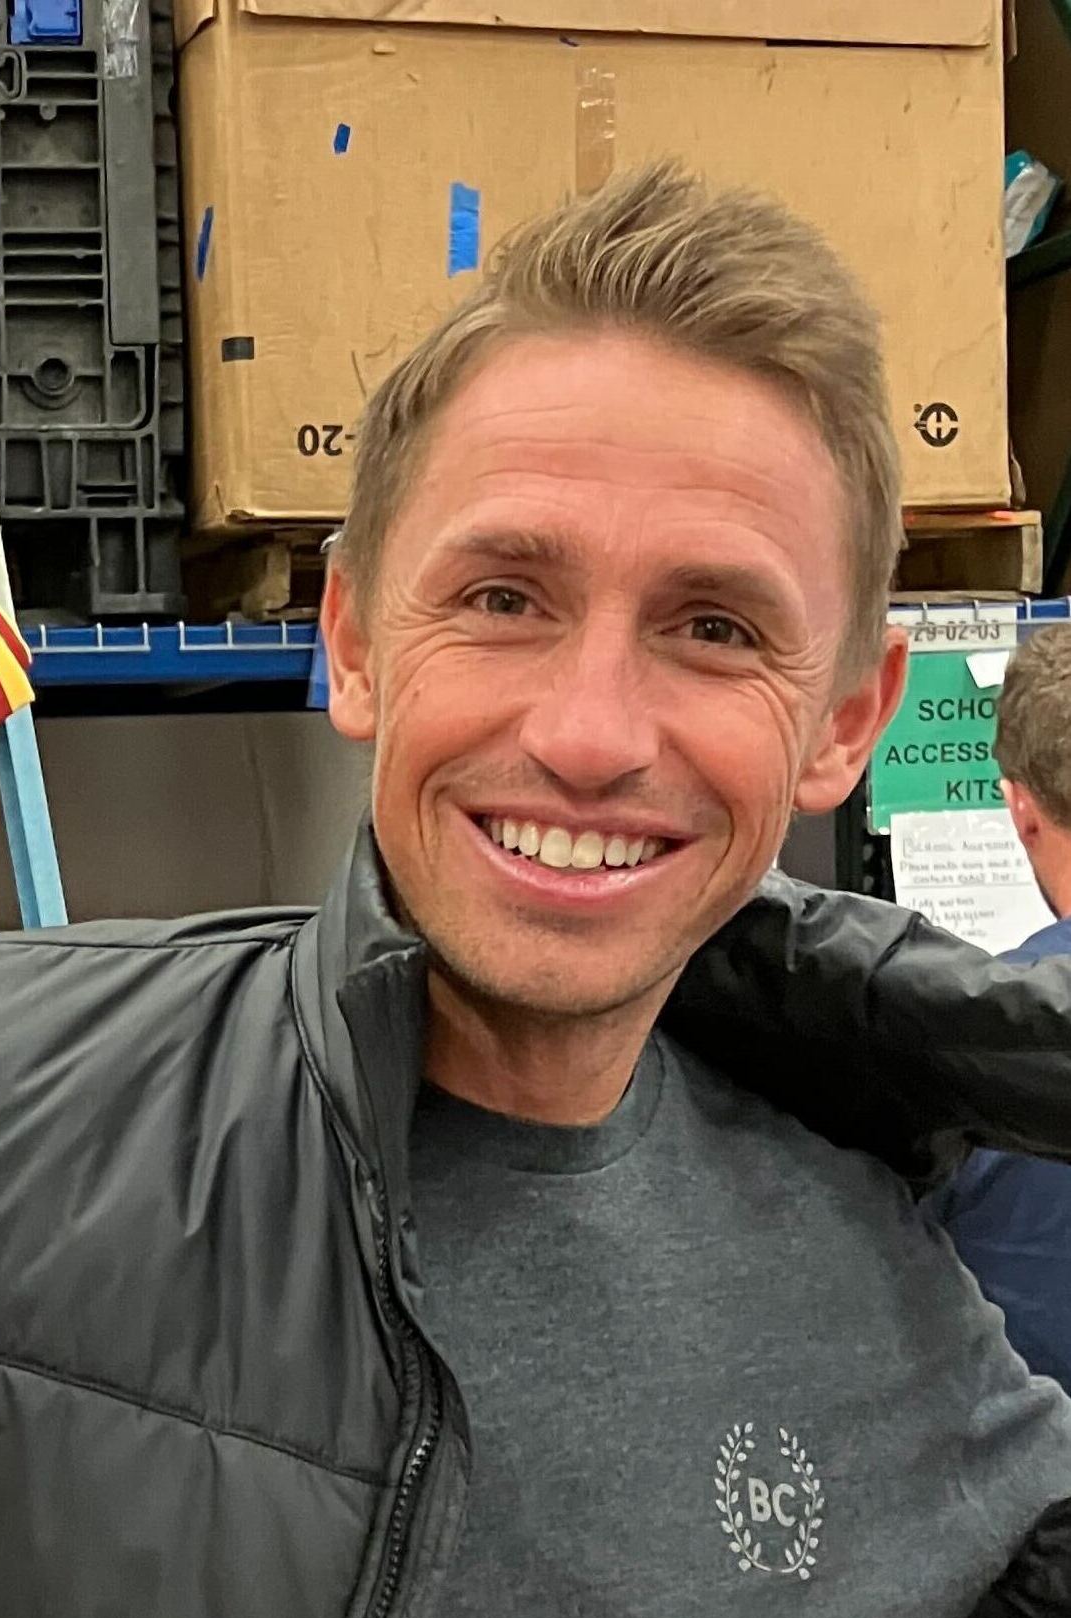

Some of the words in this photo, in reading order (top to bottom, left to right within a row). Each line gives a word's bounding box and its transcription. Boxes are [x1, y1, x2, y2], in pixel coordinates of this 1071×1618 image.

[918, 697, 996, 722] SCHO
[884, 741, 993, 766] ACCESS
[945, 777, 1005, 802] KITS
[748, 1477, 797, 1528] BC
